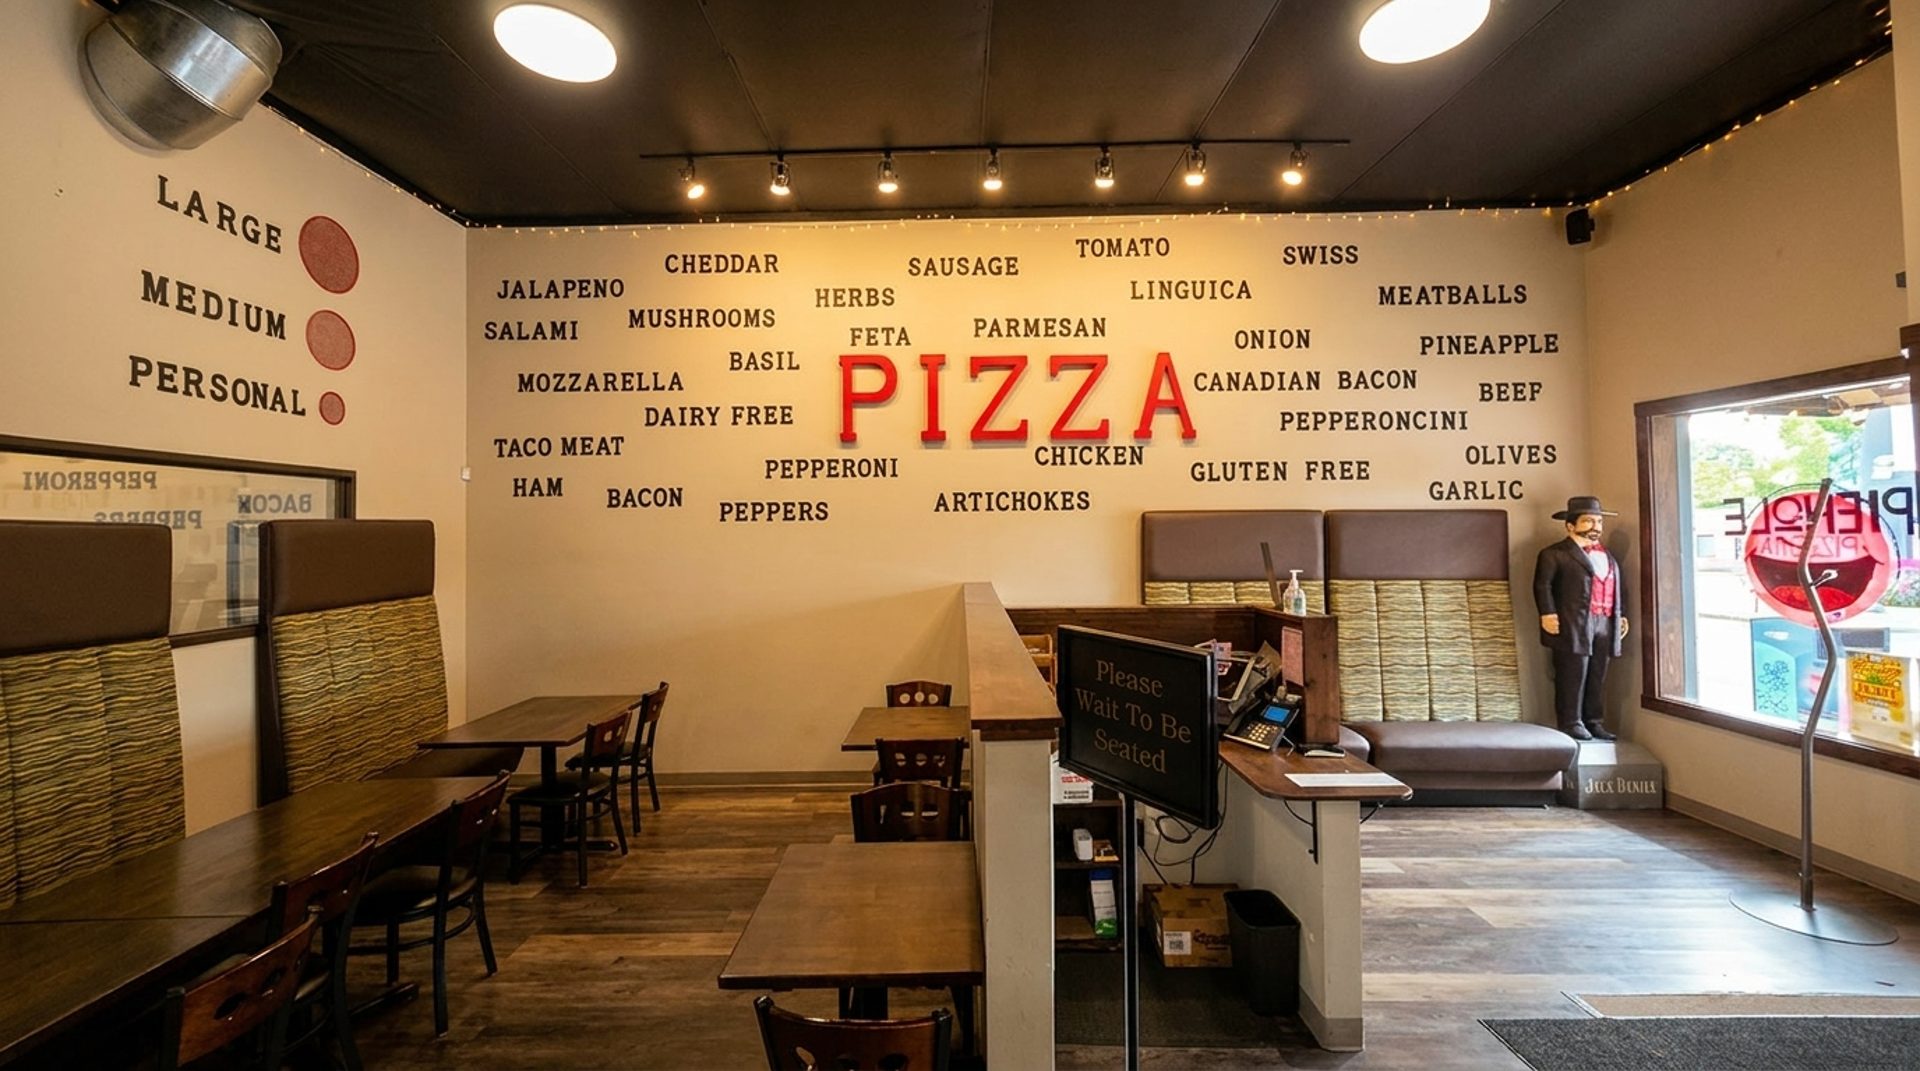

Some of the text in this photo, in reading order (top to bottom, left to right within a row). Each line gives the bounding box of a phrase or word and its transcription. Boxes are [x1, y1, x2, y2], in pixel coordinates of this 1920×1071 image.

[158, 175, 281, 254] LARGE
[1076, 238, 1169, 257] TOMATO
[1284, 245, 1358, 265] SWISS
[665, 254, 778, 273] CHEDDAR
[908, 257, 1018, 276] SAUSAGE
[497, 279, 623, 299] JALAPENO
[816, 288, 894, 307] HERBS
[1131, 280, 1251, 299] LINGUICA
[1379, 285, 1527, 305] MEATBALLS
[141, 270, 285, 340] MEDIUM
[629, 309, 774, 328] MUSHROOMS
[974, 318, 1105, 337] PARMESAN
[485, 321, 577, 340] SALAMI
[850, 327, 911, 346] FETA
[1235, 329, 1310, 349] ONION
[1421, 334, 1558, 355] PINEAPPLE
[730, 352, 799, 371] BASIL
[129, 355, 305, 416] PERSONAL
[518, 372, 683, 392] MOZZARELLA
[1194, 370, 1416, 391] CANADIAN BACON
[838, 352, 1197, 443] PIZZA
[1479, 382, 1542, 401] BEEF
[645, 406, 793, 426] DAIRY FREE
[1281, 411, 1467, 431] PEPPERONCINI
[494, 437, 624, 457] TACO MEAT
[1035, 446, 1144, 465] CHICKEN
[1466, 445, 1556, 464] OLIVES
[766, 459, 898, 479] PEPPERONI
[1191, 461, 1369, 481] GLUTEN FREE
[513, 478, 562, 497] HAM
[1430, 480, 1523, 500] GARLIC
[607, 488, 682, 508] BACON
[934, 491, 1089, 512] ARTICHOKES
[720, 502, 828, 522] PEPPERS
[1096, 659, 1163, 698] Please
[1075, 688, 1192, 743] Wait To Be
[1094, 728, 1167, 774] Seated
